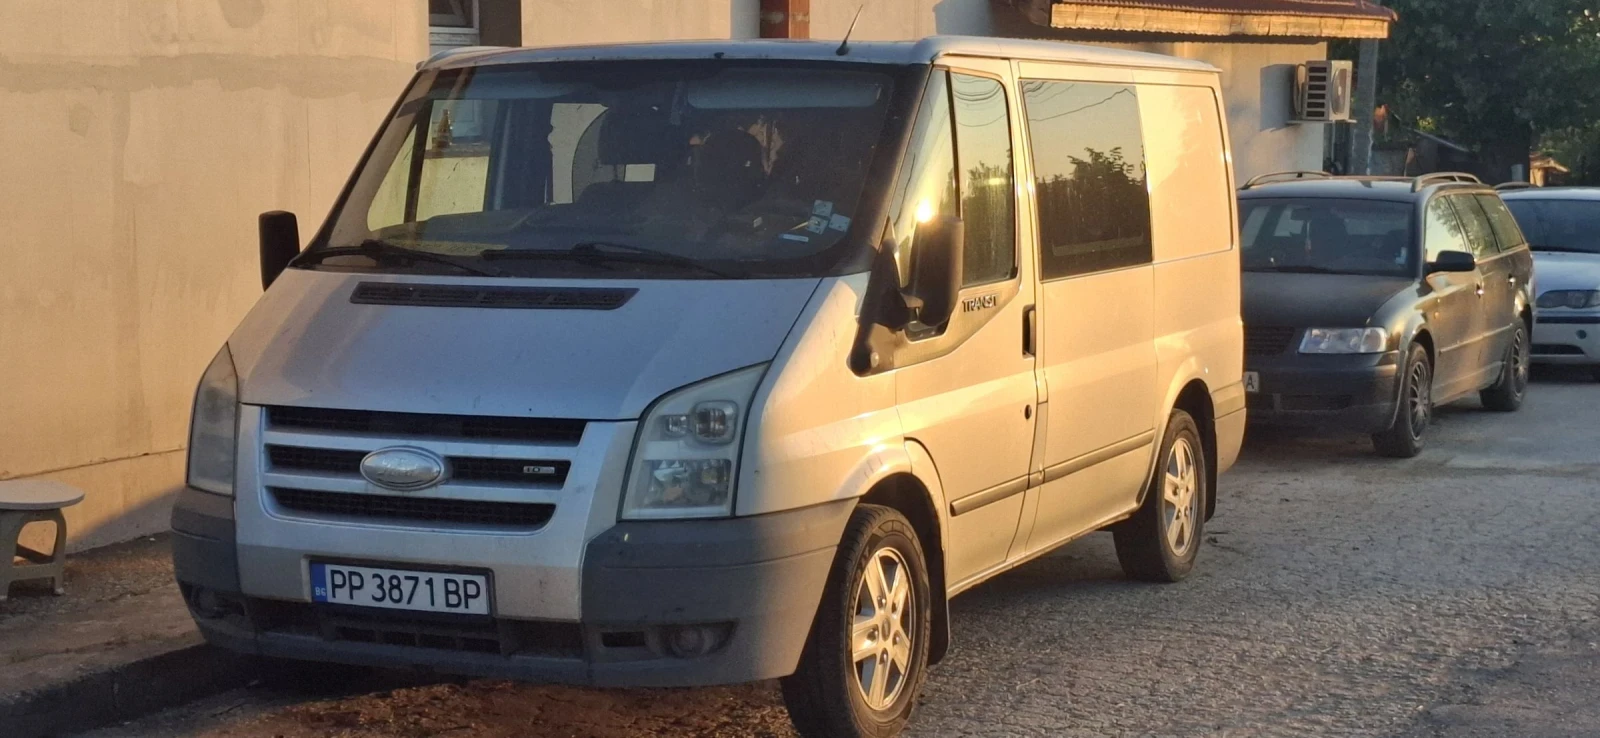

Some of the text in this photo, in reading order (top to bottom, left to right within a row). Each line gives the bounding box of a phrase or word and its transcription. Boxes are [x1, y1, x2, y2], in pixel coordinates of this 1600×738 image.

[315, 586, 327, 597] BG
[330, 569, 481, 609] PP 3871 BP
